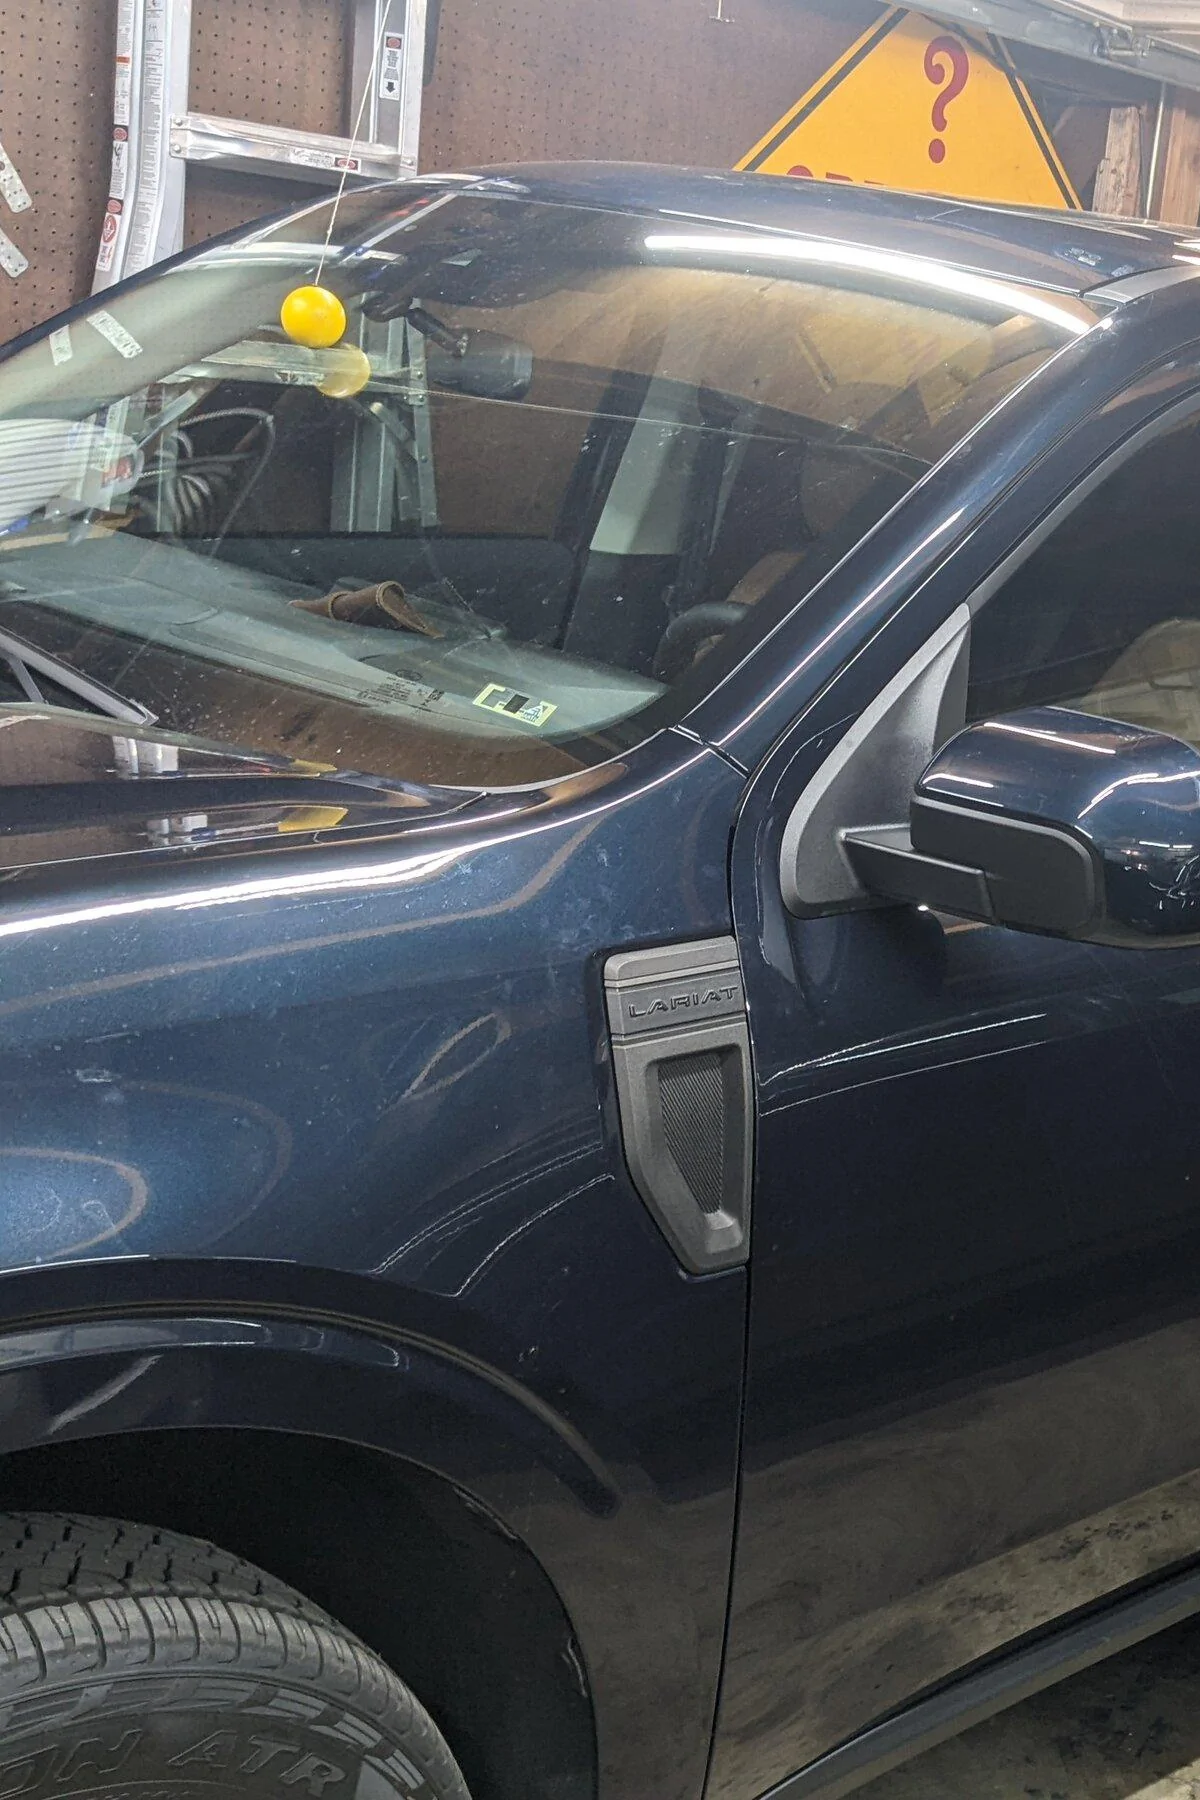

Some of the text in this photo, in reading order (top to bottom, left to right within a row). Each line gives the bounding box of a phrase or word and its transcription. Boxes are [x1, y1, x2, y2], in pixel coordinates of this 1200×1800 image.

[923, 35, 969, 164] ?
[628, 986, 739, 1018] LARIAT
[167, 1729, 346, 1798] ATR
